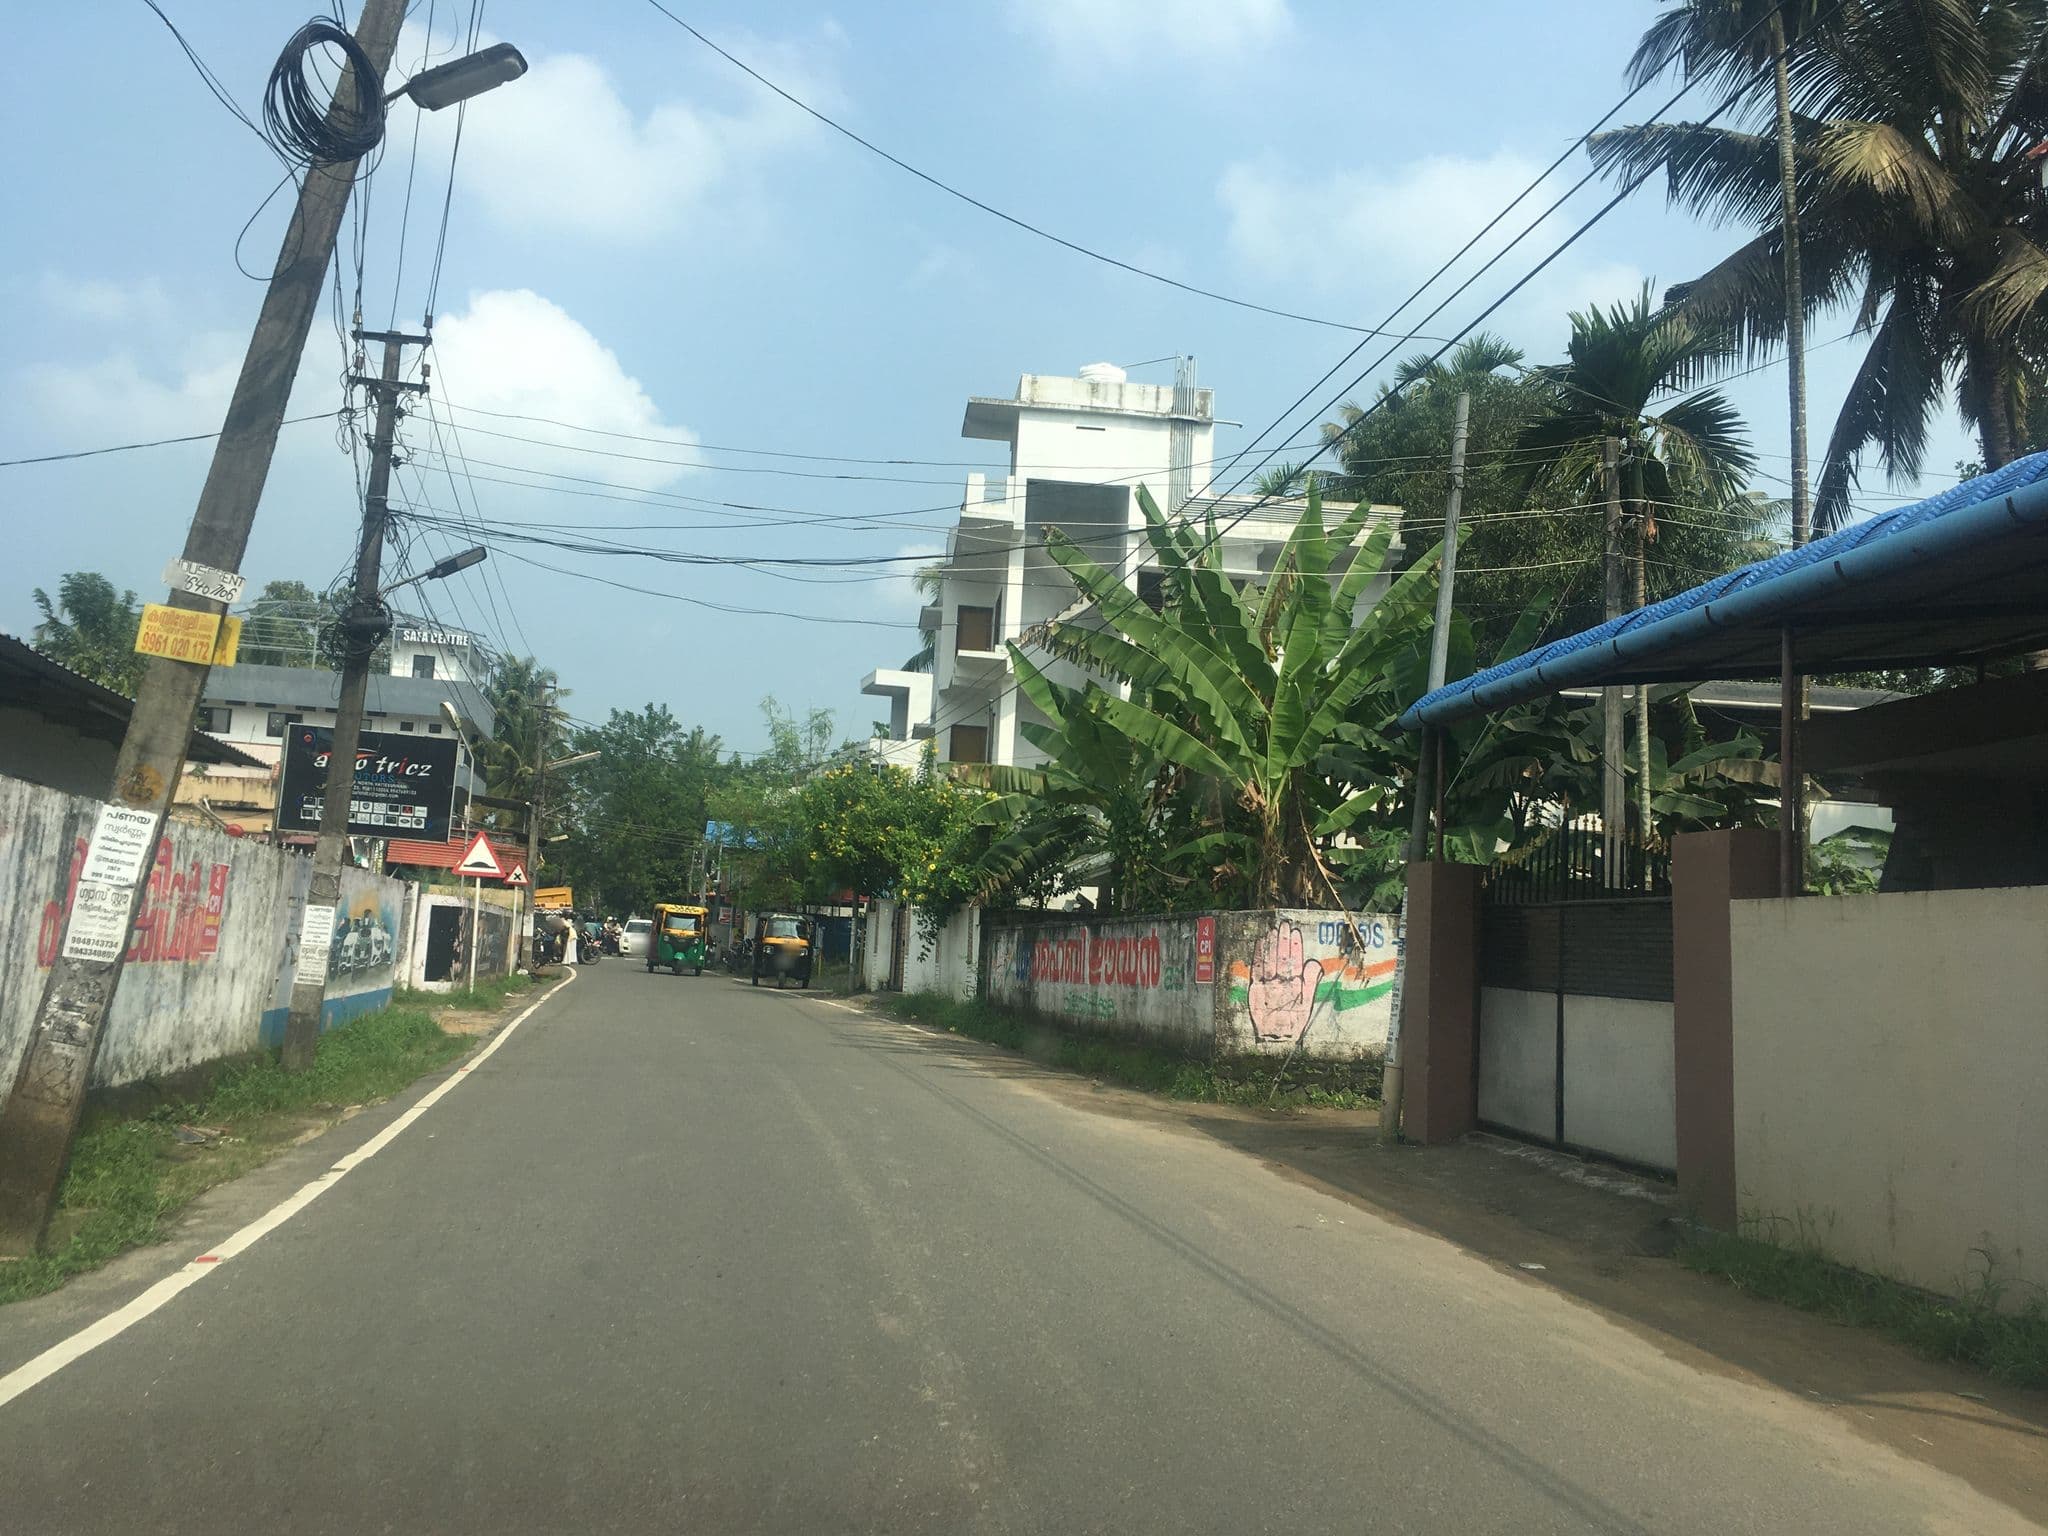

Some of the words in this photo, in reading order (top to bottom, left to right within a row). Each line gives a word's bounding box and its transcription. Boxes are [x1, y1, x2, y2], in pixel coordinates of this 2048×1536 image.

[403, 630, 428, 643] SAFA
[430, 632, 469, 646] CENTRE
[141, 632, 169, 654] 9961
[171, 637, 190, 657] 020
[192, 640, 210, 661] 172
[313, 754, 367, 771] ao
[376, 755, 432, 777] tricz
[106, 811, 151, 825] പണയ
[1200, 939, 1212, 954] CPI
